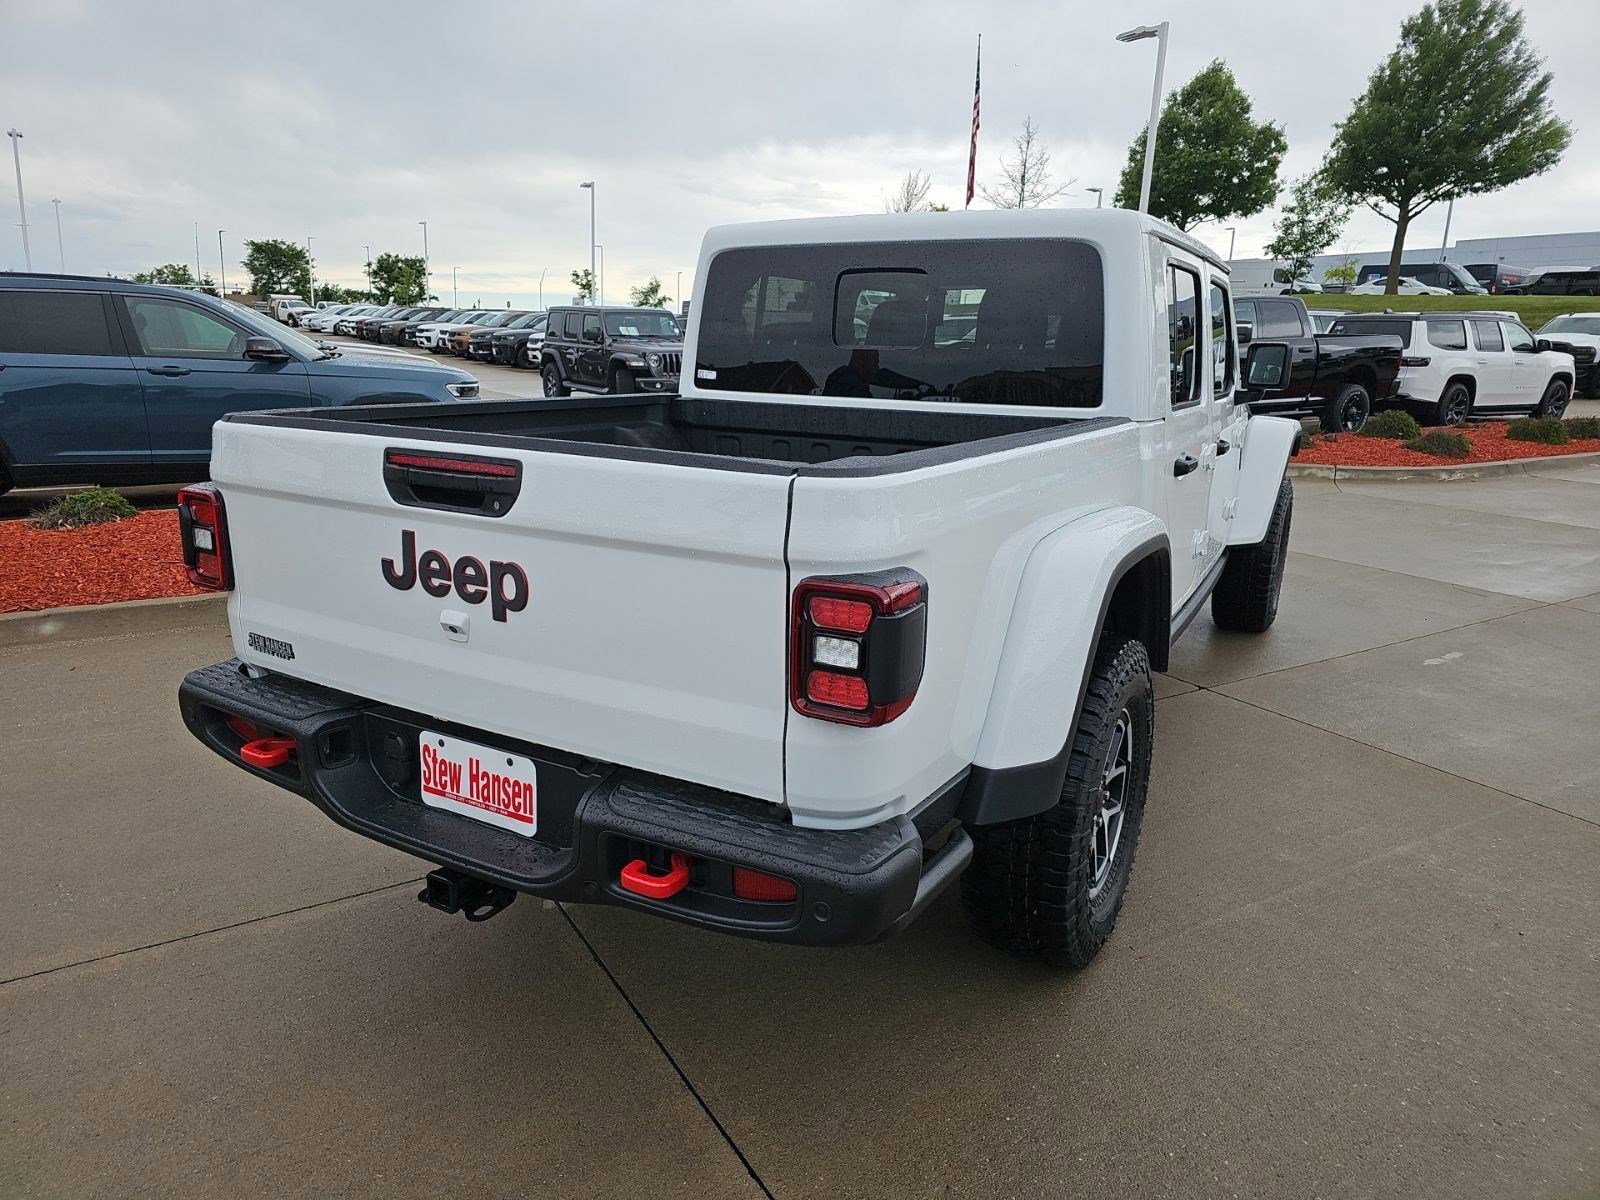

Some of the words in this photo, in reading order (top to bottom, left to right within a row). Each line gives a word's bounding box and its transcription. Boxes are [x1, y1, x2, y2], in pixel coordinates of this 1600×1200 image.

[381, 529, 529, 623] Jeep
[422, 743, 462, 794] Stew
[469, 757, 533, 816] Hansen
